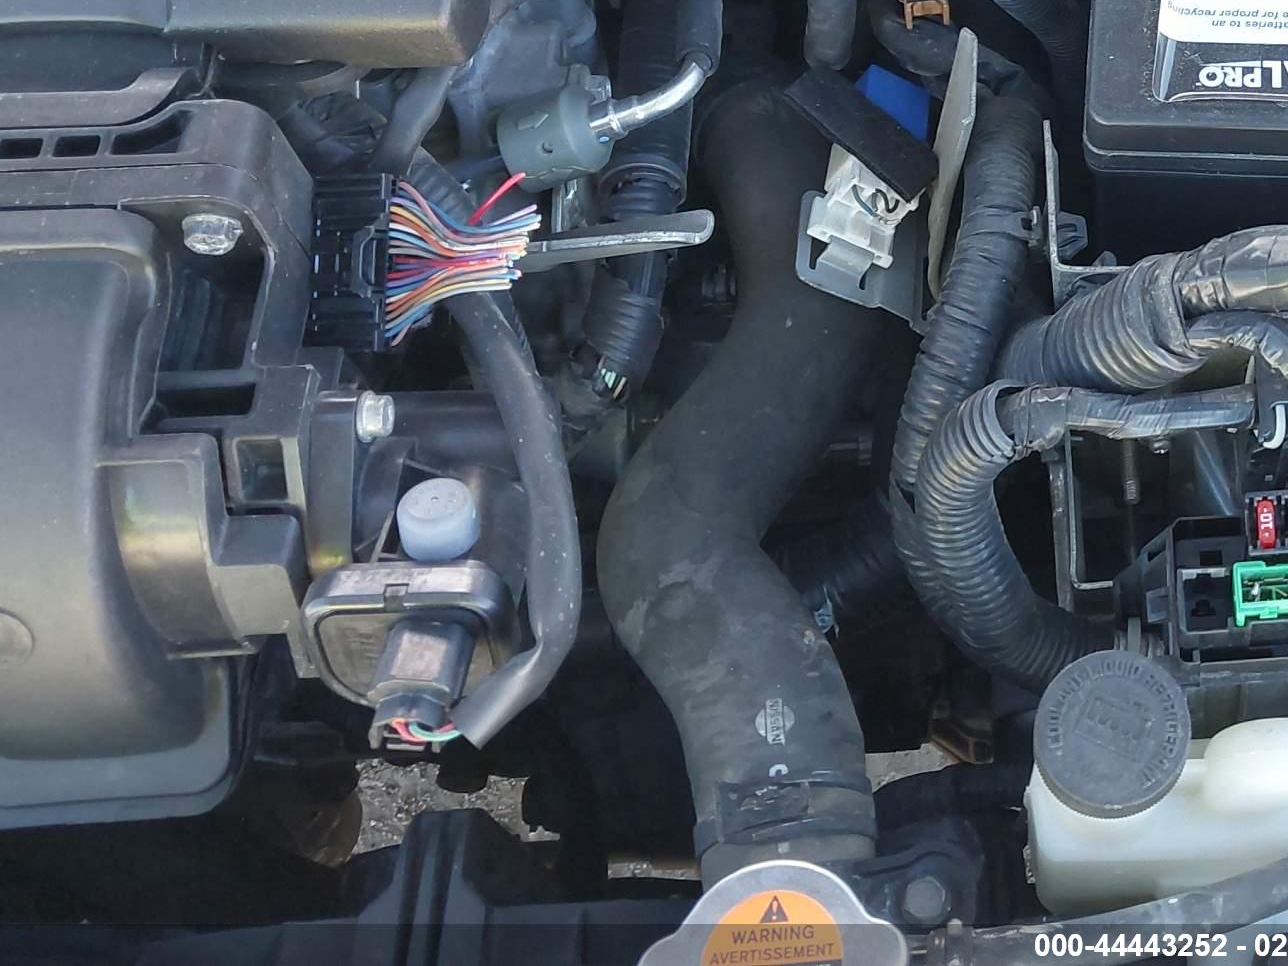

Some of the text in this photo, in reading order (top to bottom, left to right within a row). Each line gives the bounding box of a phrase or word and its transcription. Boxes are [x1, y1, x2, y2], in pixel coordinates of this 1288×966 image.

[1218, 7, 1259, 18] proper
[1261, 10, 1279, 20] for
[1211, 19, 1226, 27] an
[1229, 20, 1241, 29] to
[1260, 513, 1273, 530] 10
[768, 700, 785, 744] NISSAN
[731, 924, 815, 945] WARNING
[710, 942, 835, 965] AVERTISSEMENT
